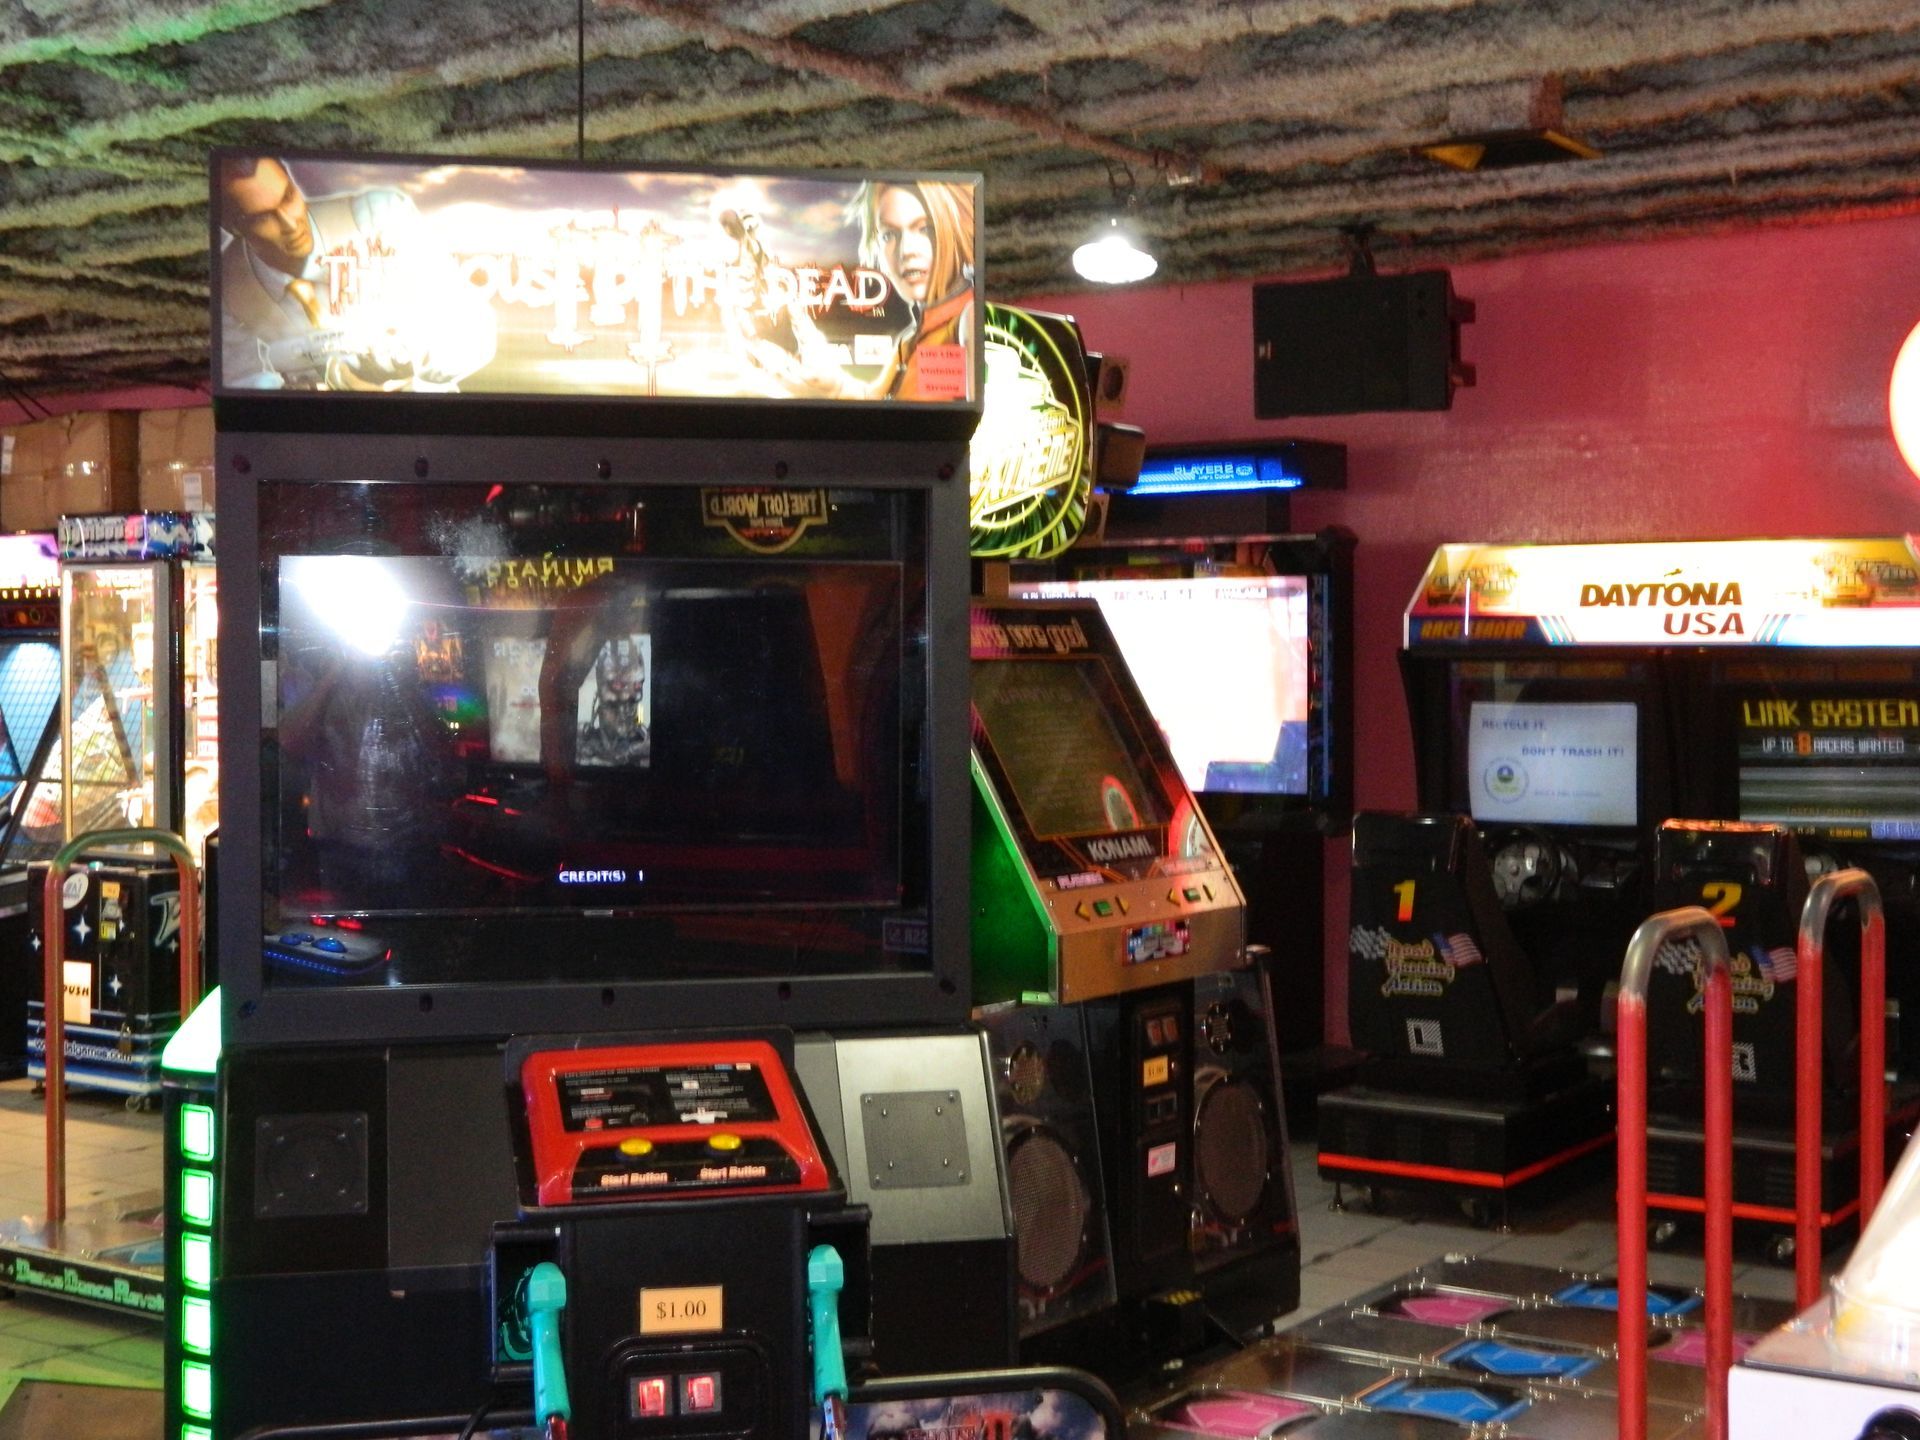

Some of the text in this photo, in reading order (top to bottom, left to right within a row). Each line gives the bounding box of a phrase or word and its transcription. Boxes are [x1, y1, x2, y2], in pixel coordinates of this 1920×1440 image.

[760, 264, 890, 308] DEAD
[1173, 461, 1224, 476] PLAYER
[1580, 583, 1743, 607] DAYTONA
[1663, 612, 1744, 635] USA
[1743, 701, 1919, 727] LINK SYSTEM
[1762, 738, 1776, 752] UP
[1858, 738, 1905, 753] WANTED
[1087, 834, 1153, 862] KONAMI
[559, 870, 626, 883] CREDIT(S)
[1393, 880, 1416, 922] 1
[1703, 882, 1743, 927] 2
[601, 1171, 669, 1187] Start Button
[701, 1165, 767, 1181] Start Button
[656, 1300, 708, 1320] $1.00
